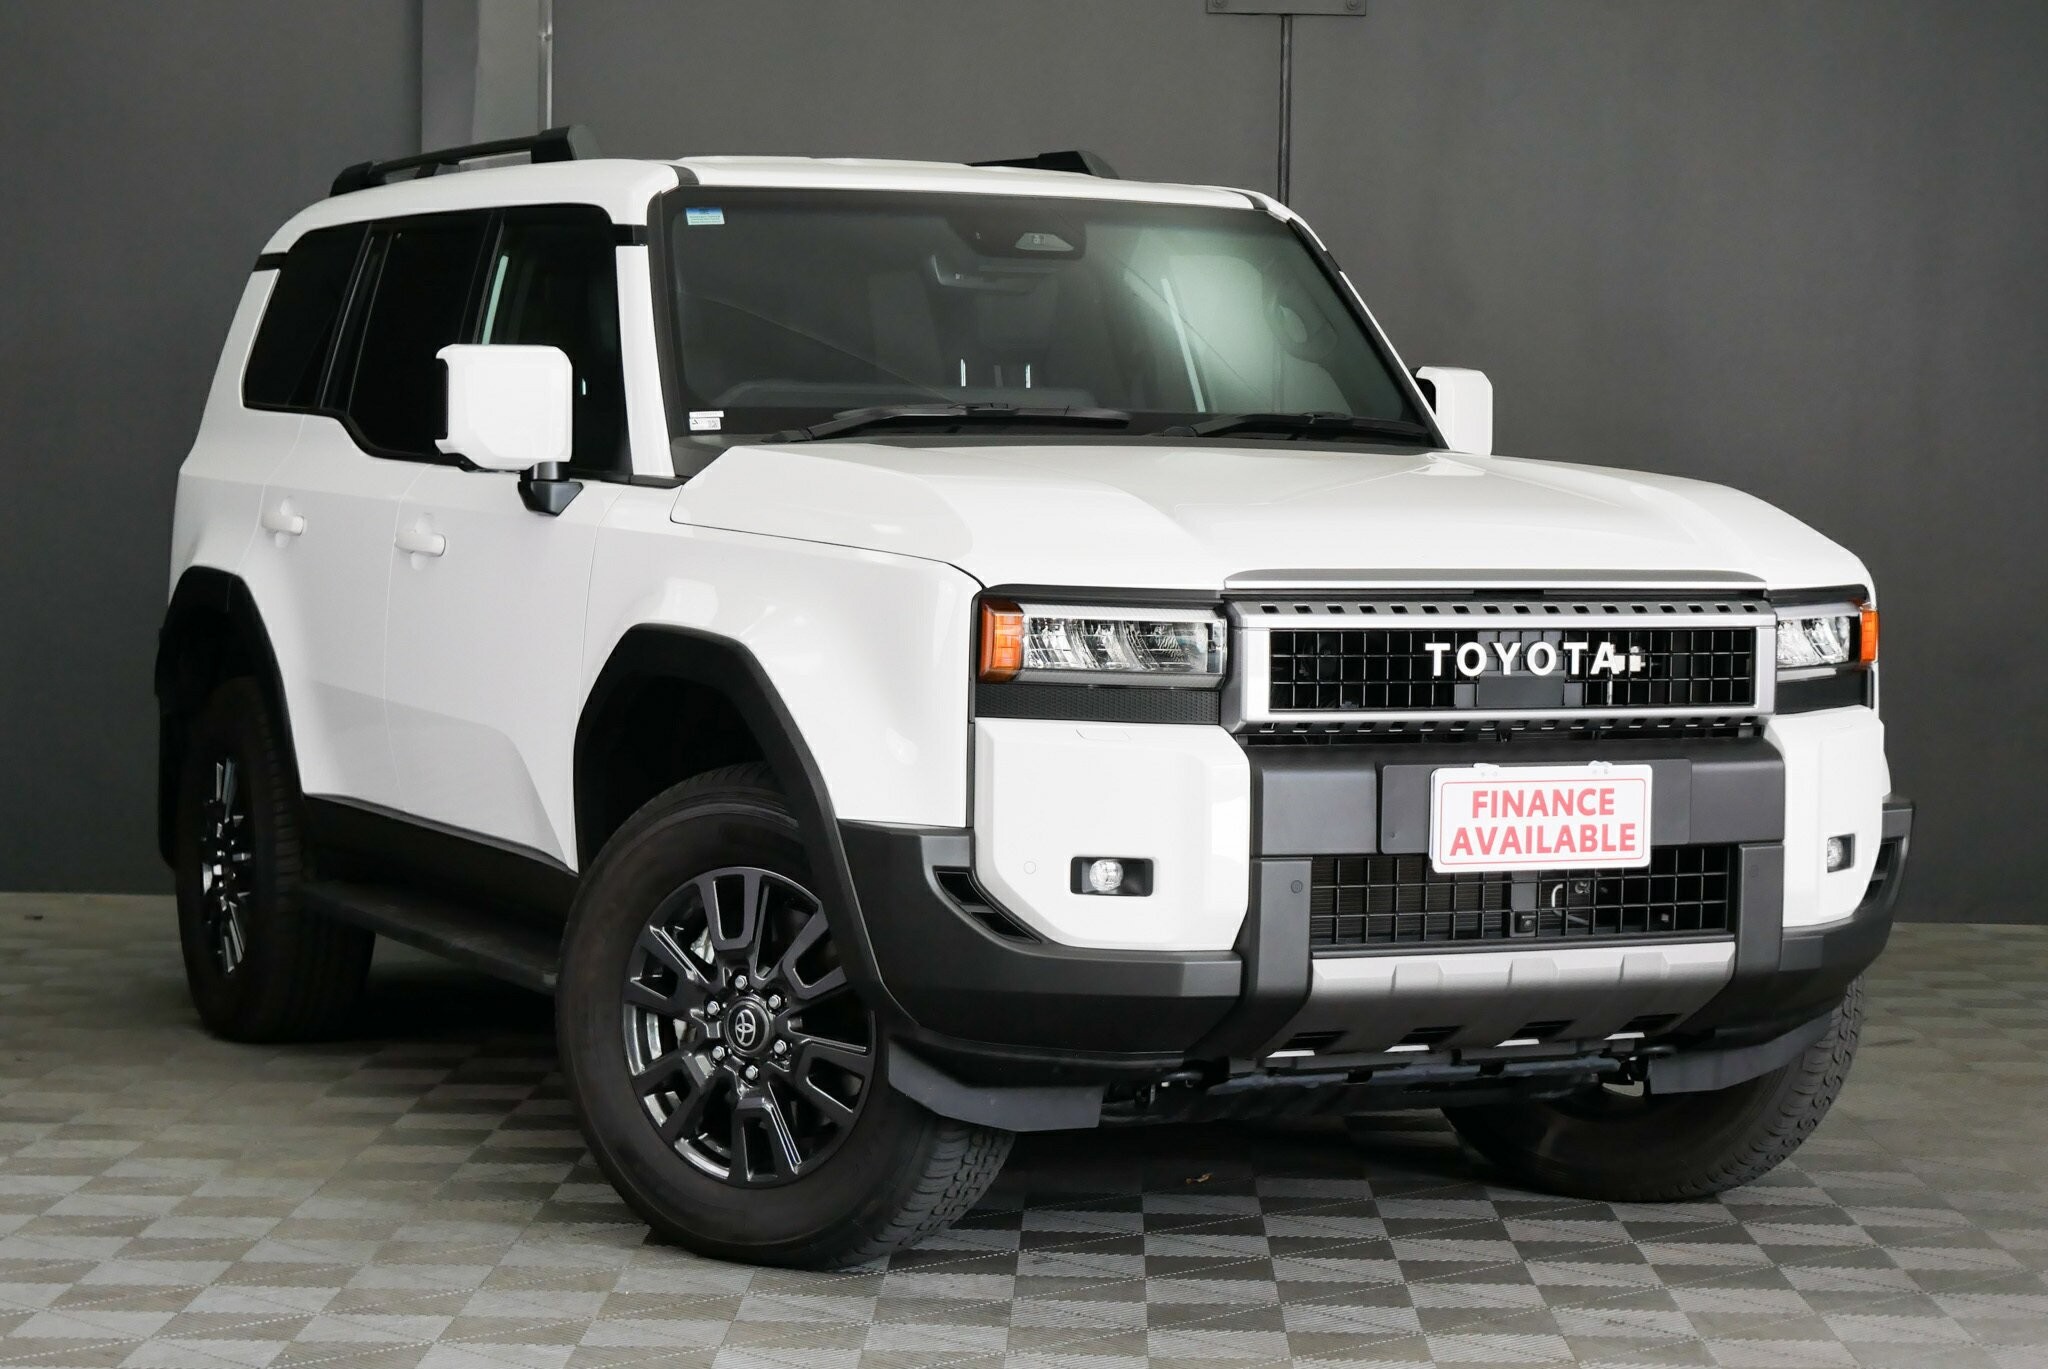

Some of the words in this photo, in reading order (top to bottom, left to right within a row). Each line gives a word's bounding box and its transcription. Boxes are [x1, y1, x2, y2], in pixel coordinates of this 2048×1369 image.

[1425, 641, 1620, 676] TOYOTA
[1472, 788, 1615, 818] FINANCE
[1449, 823, 1636, 856] AVAILABLE
